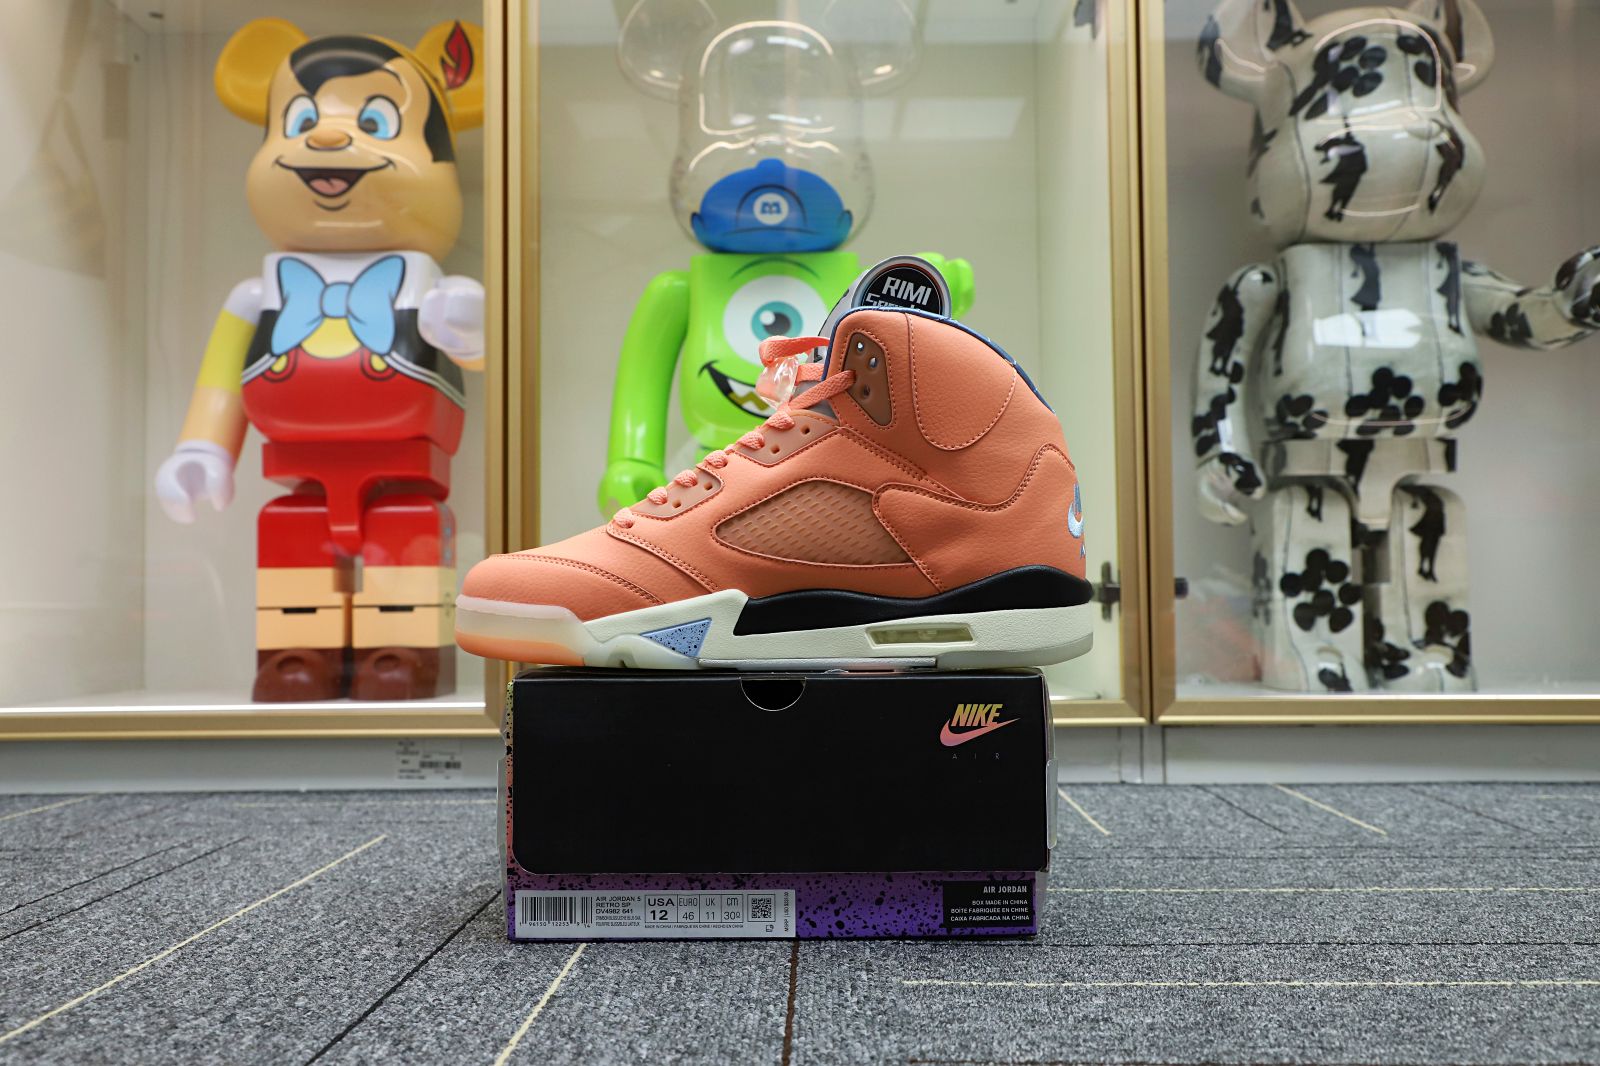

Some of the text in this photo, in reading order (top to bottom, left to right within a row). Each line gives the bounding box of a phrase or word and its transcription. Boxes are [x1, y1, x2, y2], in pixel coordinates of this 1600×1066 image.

[881, 276, 932, 306] RIMI
[951, 703, 1003, 727] NIKE
[998, 885, 1027, 893] JORDAN
[648, 897, 675, 907] USA
[679, 897, 698, 907] EURO
[705, 898, 716, 907] UK
[650, 909, 669, 921] 12
[682, 911, 695, 920] 46
[705, 911, 715, 920] 11
